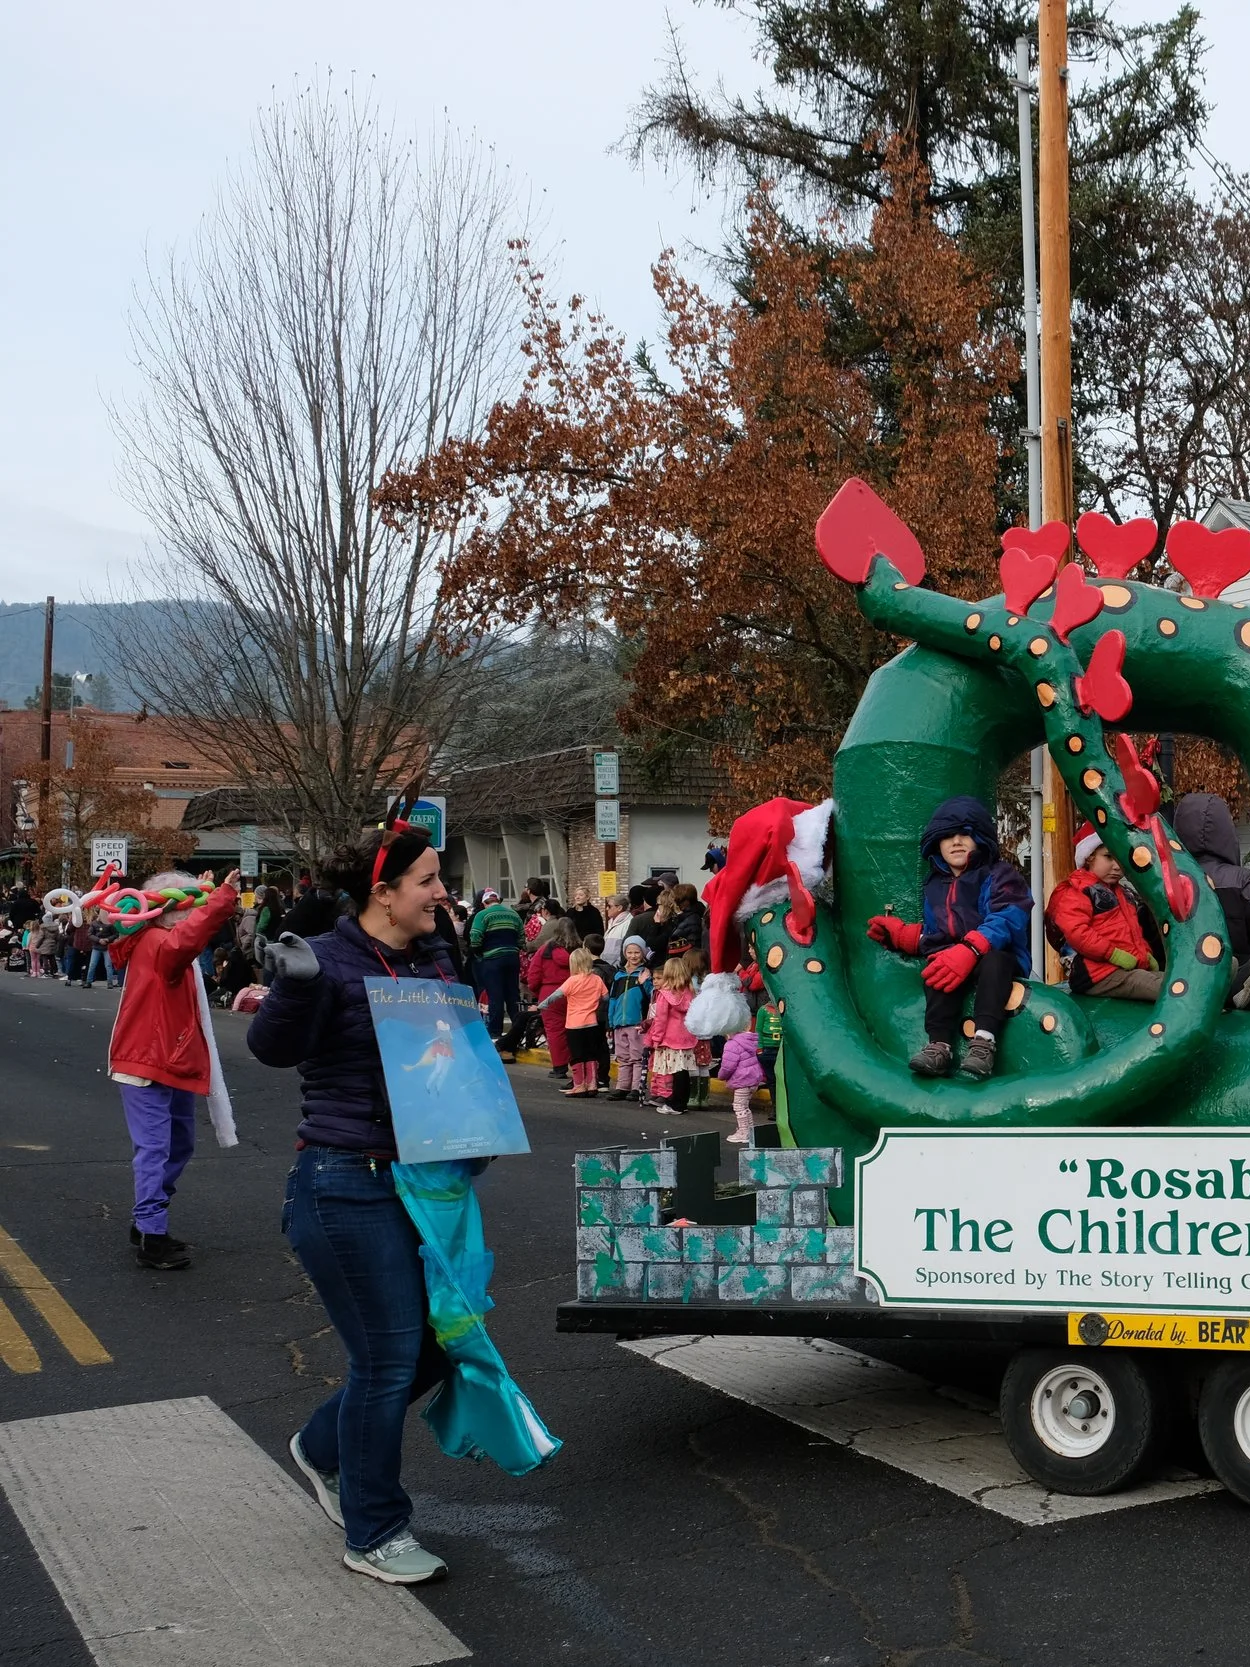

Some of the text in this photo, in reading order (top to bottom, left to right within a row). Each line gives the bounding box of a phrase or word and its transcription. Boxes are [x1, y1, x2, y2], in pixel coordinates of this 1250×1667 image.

[95, 842, 123, 850] SPEED
[370, 988, 478, 1010] The Little Mermaid
[914, 1207, 1013, 1253] The
[915, 1267, 1015, 1288] Sponsored
[1025, 1268, 1047, 1290] by
[1057, 1269, 1092, 1287] The
[1101, 1270, 1154, 1292] Story
[1164, 1271, 1233, 1295] Telling
[1107, 1319, 1166, 1342] Donated
[1198, 1321, 1246, 1345] BEAR
